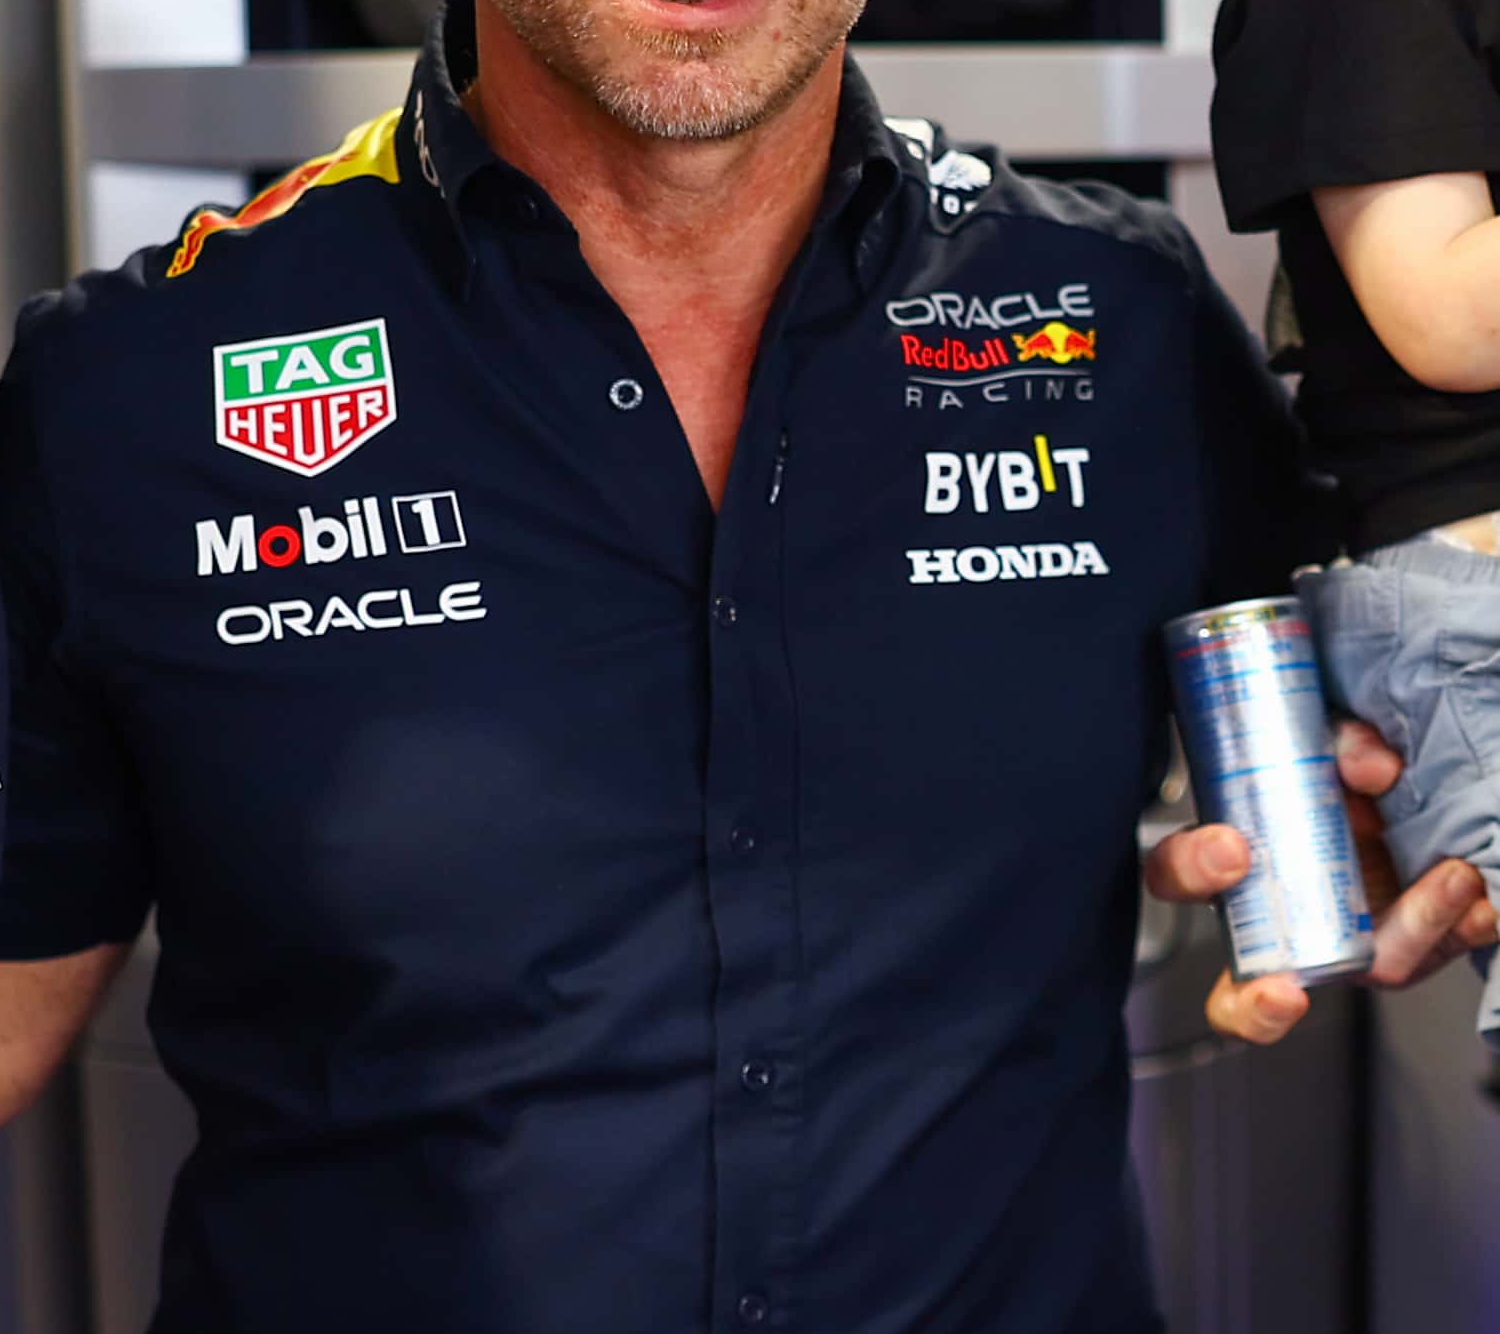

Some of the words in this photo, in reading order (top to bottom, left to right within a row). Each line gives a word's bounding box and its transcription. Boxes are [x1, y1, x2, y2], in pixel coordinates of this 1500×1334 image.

[885, 283, 1094, 329] ORACLE
[237, 331, 376, 392] TAG
[901, 333, 951, 370] Red
[951, 335, 1009, 369] Bull
[906, 378, 1094, 409] RACING
[226, 386, 386, 466] HEUER
[924, 434, 1090, 514] BYBIT
[196, 497, 386, 575] Mobil
[412, 500, 437, 549] 1
[906, 543, 1108, 583] HONDA
[217, 582, 486, 644] ORACLE
